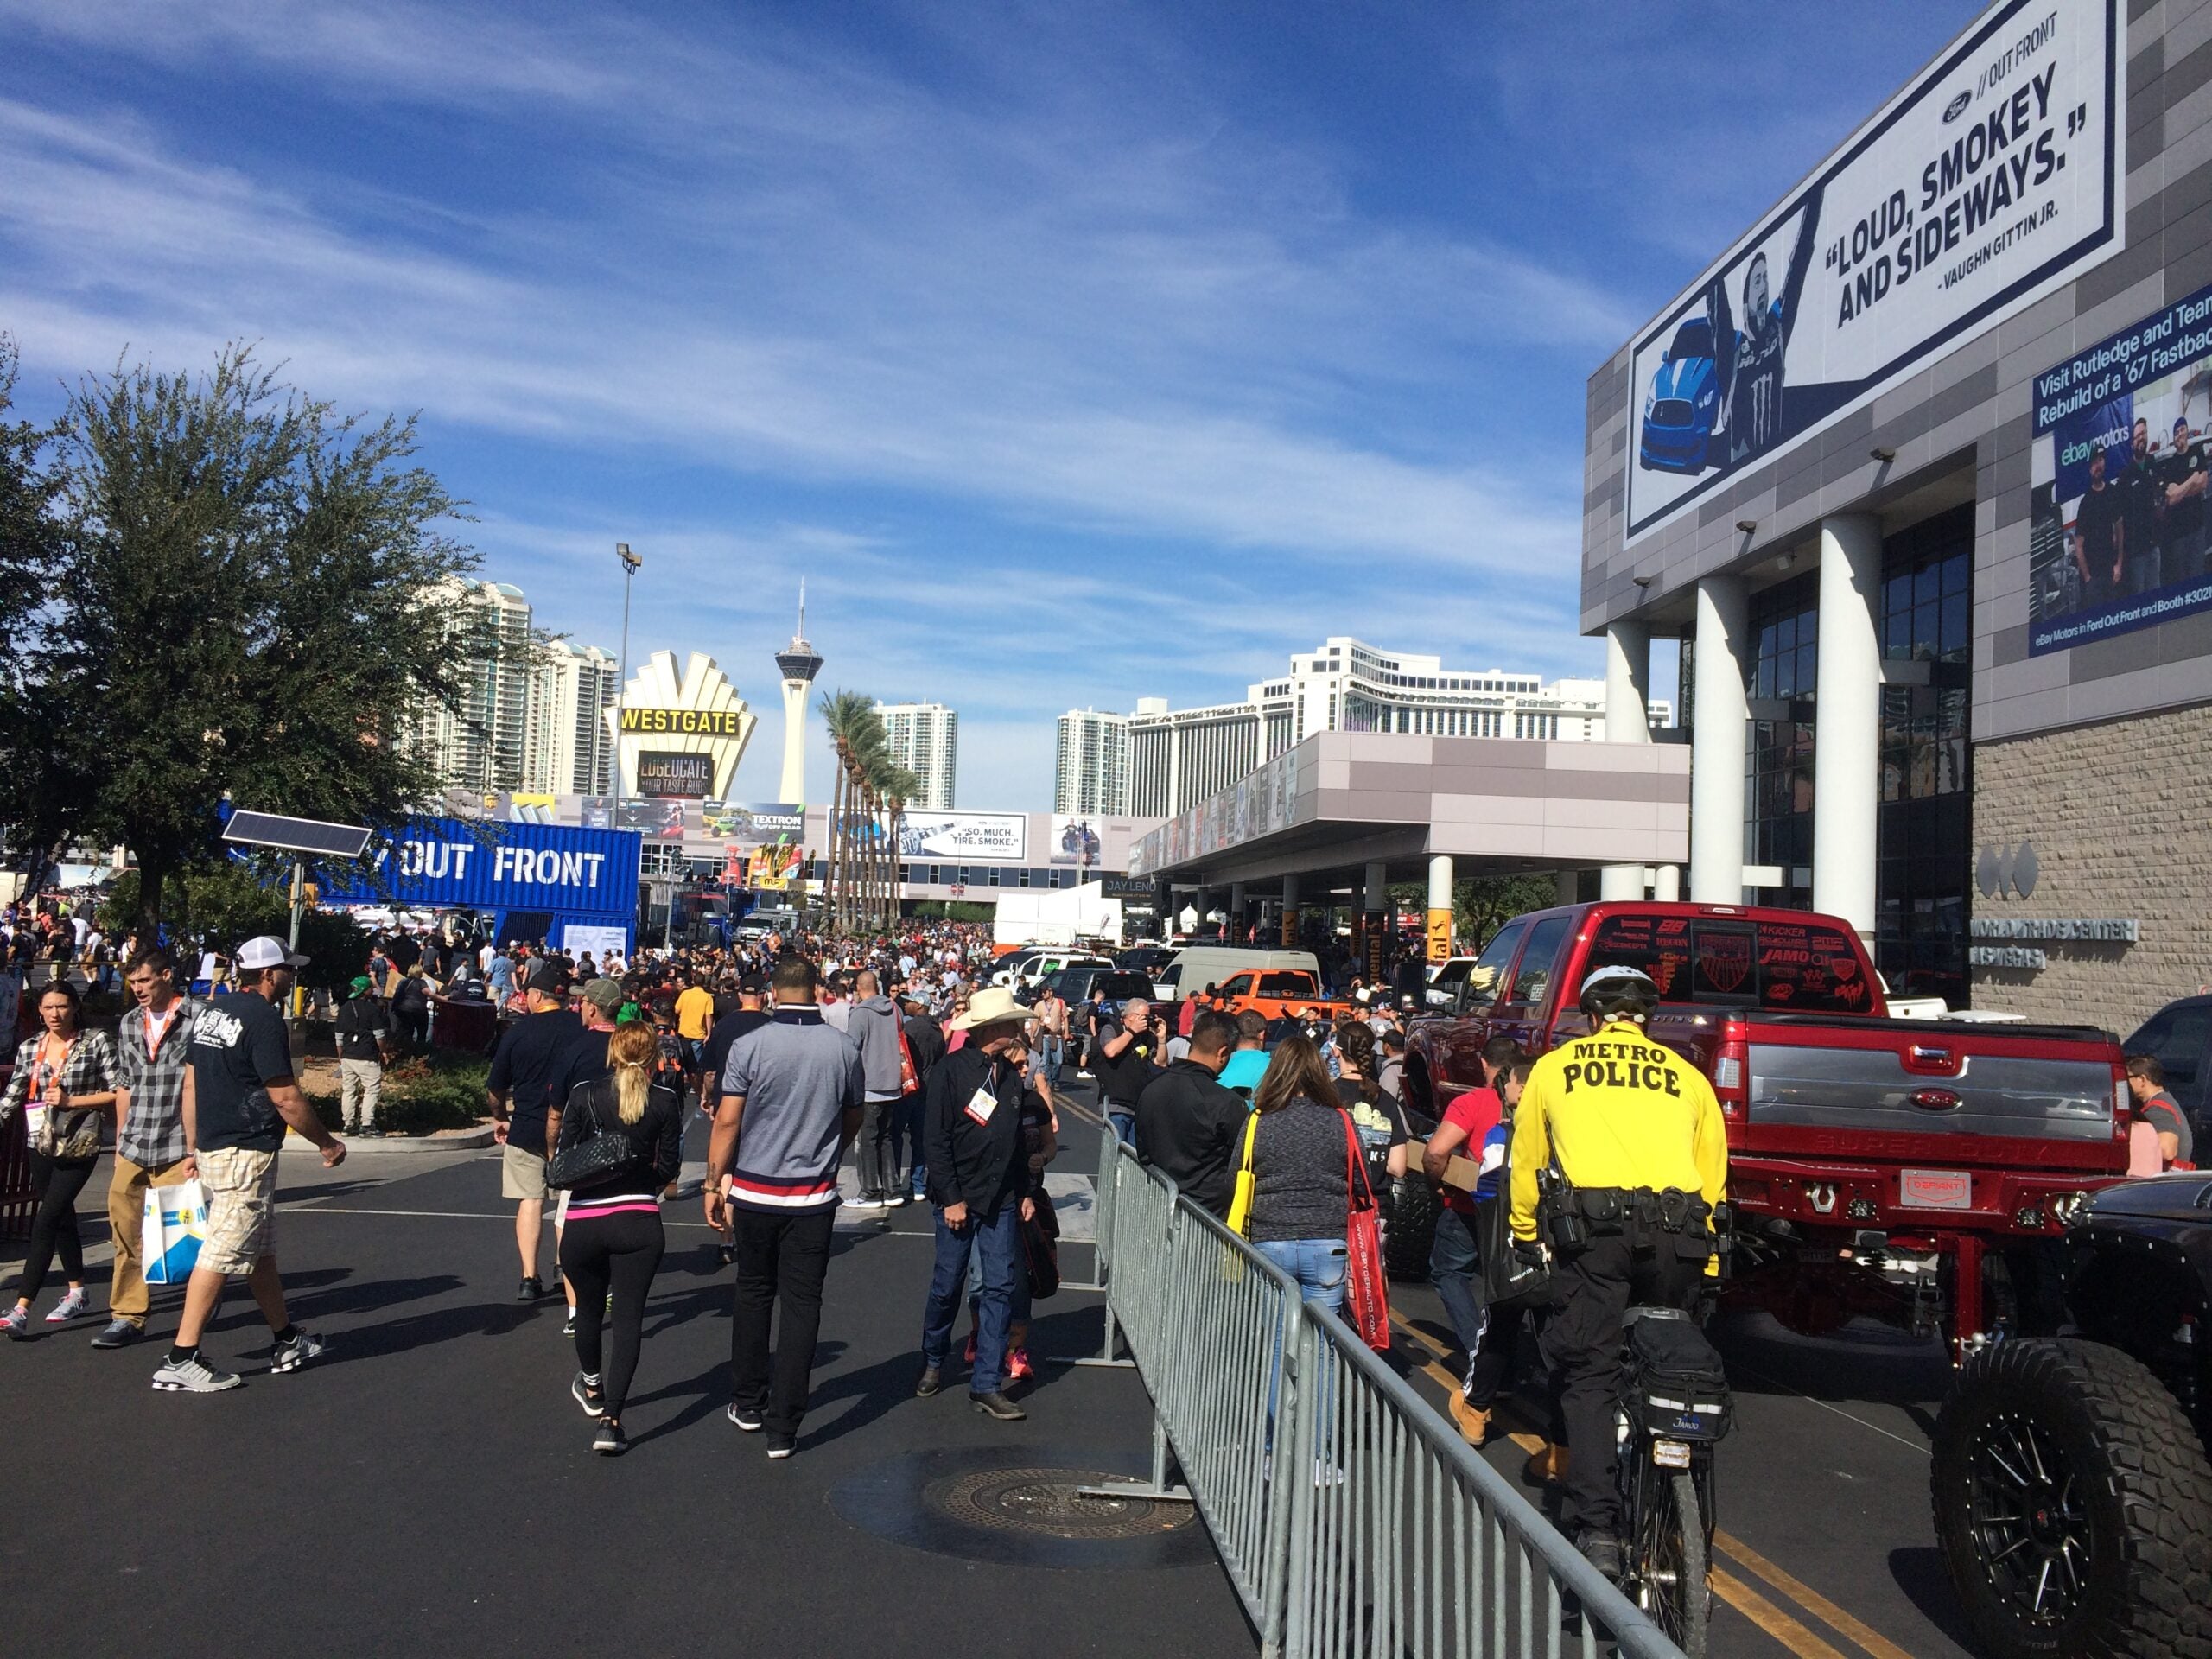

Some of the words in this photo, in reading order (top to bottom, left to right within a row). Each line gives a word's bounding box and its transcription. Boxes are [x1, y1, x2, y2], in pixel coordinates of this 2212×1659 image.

[1989, 48, 2014, 88] OUT
[2015, 10, 2057, 67] FRONT
[1920, 60, 2056, 212] SMOKEY
[1944, 242, 1992, 290] VAUGHN
[1993, 211, 2037, 256] GITTIN
[2039, 200, 2059, 227] JR.
[1837, 254, 1891, 329] AND
[2040, 365, 2070, 399] Visit
[2073, 335, 2140, 384] Rutledge
[2143, 312, 2172, 346] and
[2039, 383, 2092, 428] Rebuild
[2094, 373, 2112, 399] of
[2113, 374, 2121, 391] a
[2036, 633, 2053, 646] eBay
[2053, 626, 2078, 641] Motors
[2080, 623, 2087, 634] in
[2087, 617, 2104, 632] Ford
[2104, 613, 2120, 627] Out
[2120, 607, 2140, 623] Front
[2141, 601, 2157, 616] and
[2158, 594, 2183, 613] Booth
[621, 709, 736, 734] WESTGATE
[641, 779, 662, 792] YOUR
[663, 779, 686, 794] TASTE
[752, 815, 802, 825] TEXTRON
[953, 836, 976, 845] TIRE.
[984, 828, 1014, 837] MUCH.
[400, 840, 474, 880] OUT
[493, 846, 605, 887] FRONT
[1107, 881, 1128, 892] JAY
[1130, 881, 1156, 892] LENO
[1768, 926, 1806, 937] KICKER
[2023, 919, 2070, 940] TRADE
[2071, 919, 2138, 941] CENTER
[1433, 938, 1447, 959] tal
[1759, 950, 1809, 964] JAMO
[1997, 948, 2046, 969] VEGAS
[1574, 1043, 1666, 1064] METRO
[1563, 1061, 1681, 1098] POLICE
[1817, 1135, 1931, 1155] SUPER
[1914, 1181, 1959, 1190] DEFIANT
